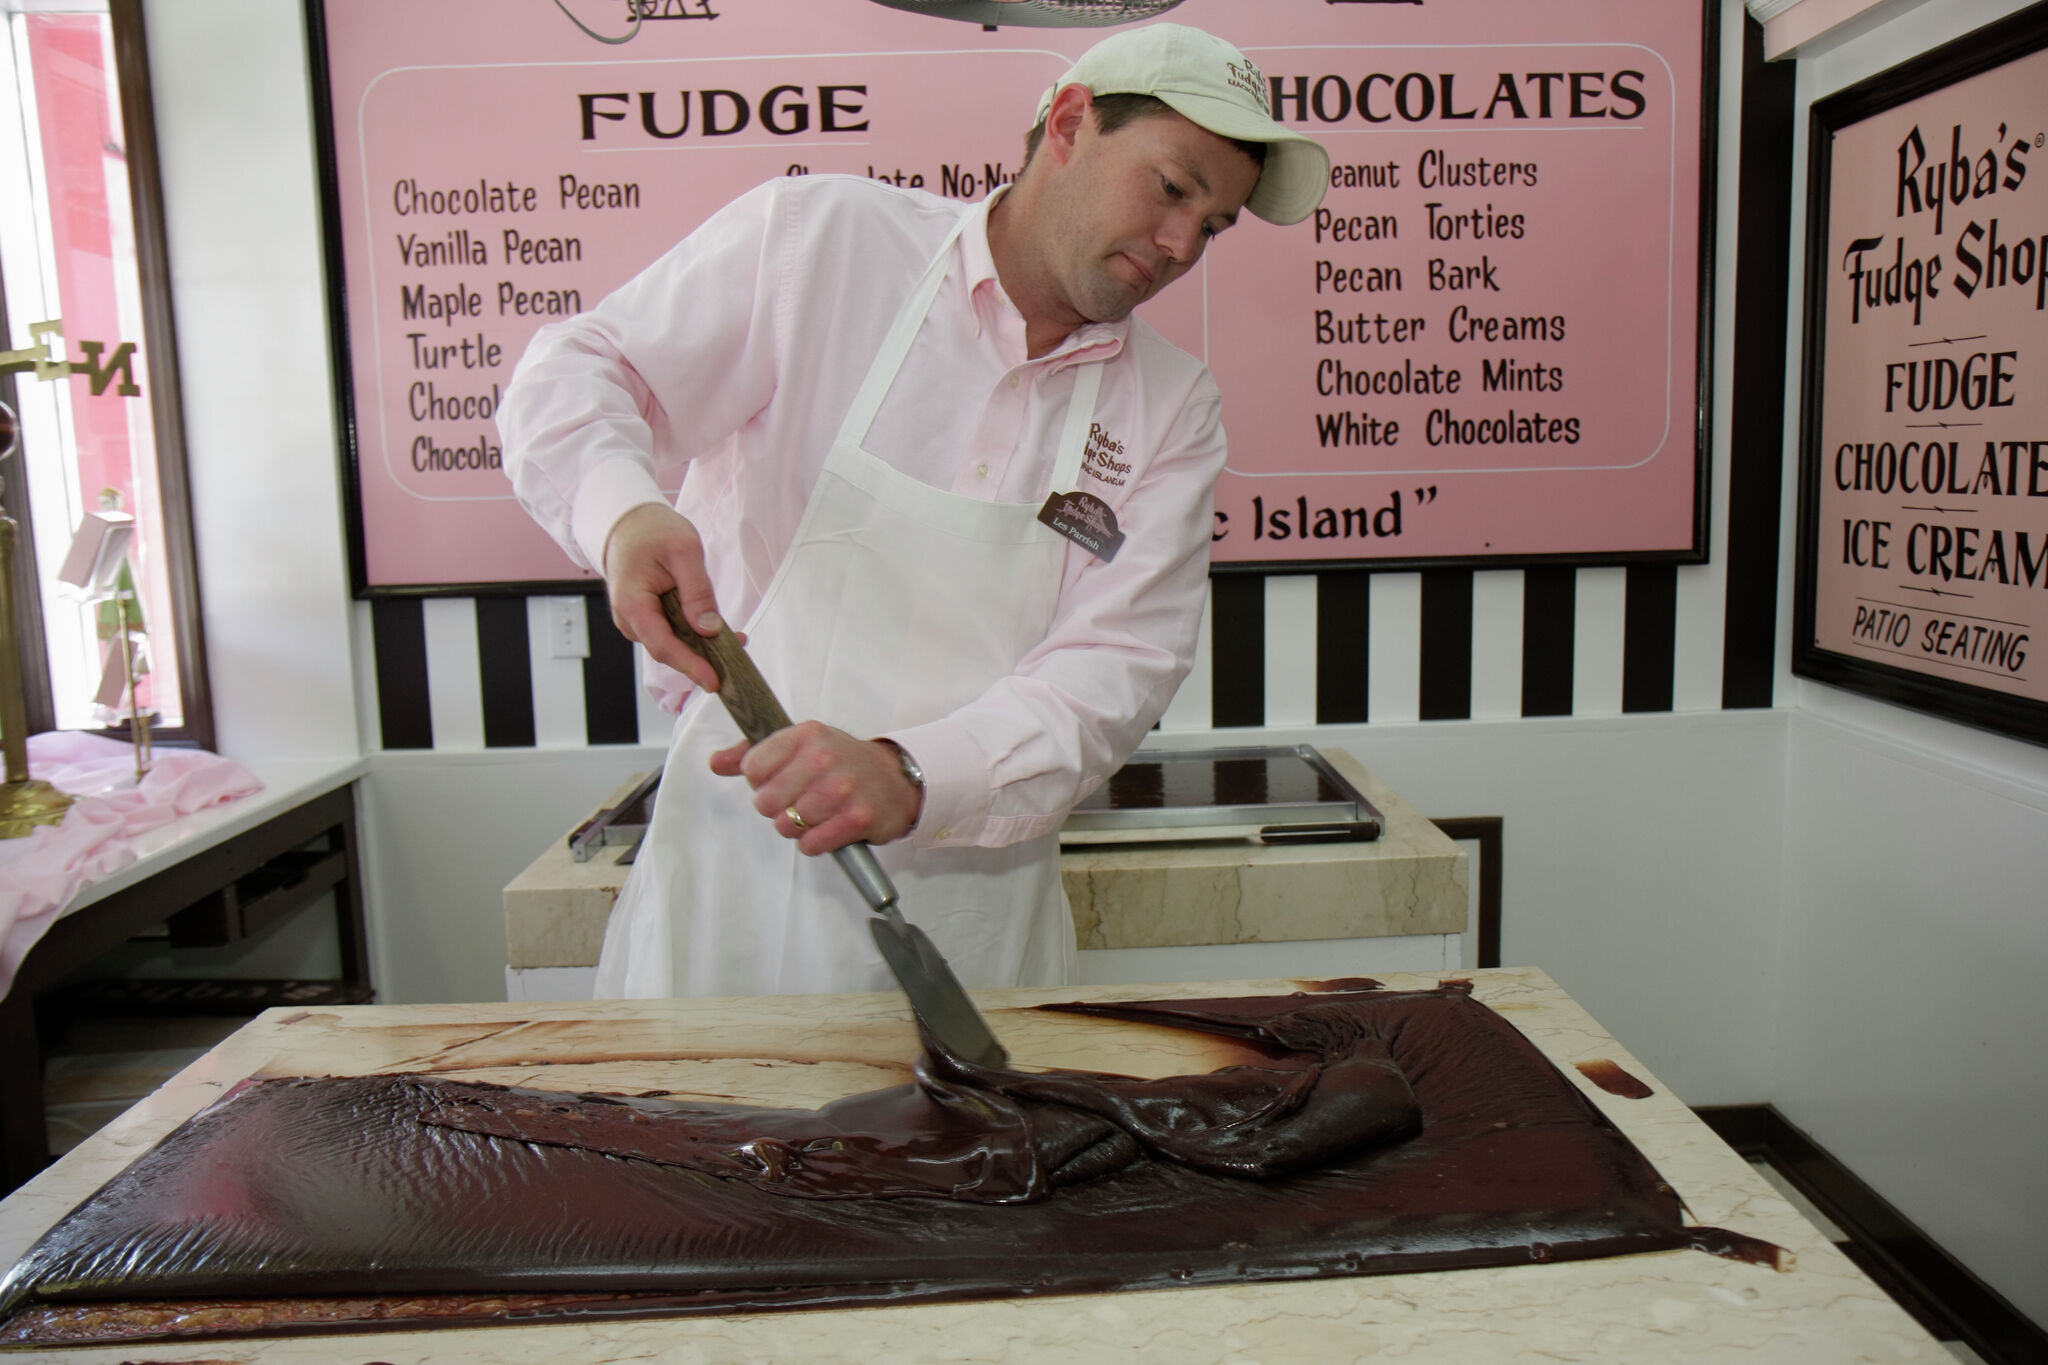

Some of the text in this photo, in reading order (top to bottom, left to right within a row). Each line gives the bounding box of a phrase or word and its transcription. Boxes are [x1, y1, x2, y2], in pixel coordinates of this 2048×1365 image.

[578, 84, 870, 140] FUDGE
[1266, 70, 1647, 123] HOCOLATES
[1331, 149, 1538, 189] eanut Clusters
[1896, 122, 2030, 234] Ryba's
[393, 173, 641, 217] Chocolate Pecan
[1314, 203, 1525, 244] Pecan Torties
[396, 228, 582, 268] Vanilla Pecan
[1315, 255, 1501, 295] Pecan Bark
[1842, 233, 1943, 326] Fudge
[401, 280, 582, 327] Maple Pecan
[1314, 306, 1566, 345] Butter Creams
[406, 332, 502, 370] Turtle
[1316, 358, 1563, 397] Chocolate Mints
[1885, 351, 2018, 412] FUDGE
[408, 381, 499, 422] Chocol
[1090, 423, 1125, 455] Ryba's
[1315, 408, 1581, 448] White Chocolates
[411, 434, 503, 473] Chocola
[1096, 451, 1132, 476] Shops
[1053, 517, 1100, 550] Les Parrish
[1842, 518, 2048, 592] ICE CREAM
[1853, 605, 2030, 672] PATIO SEATING
